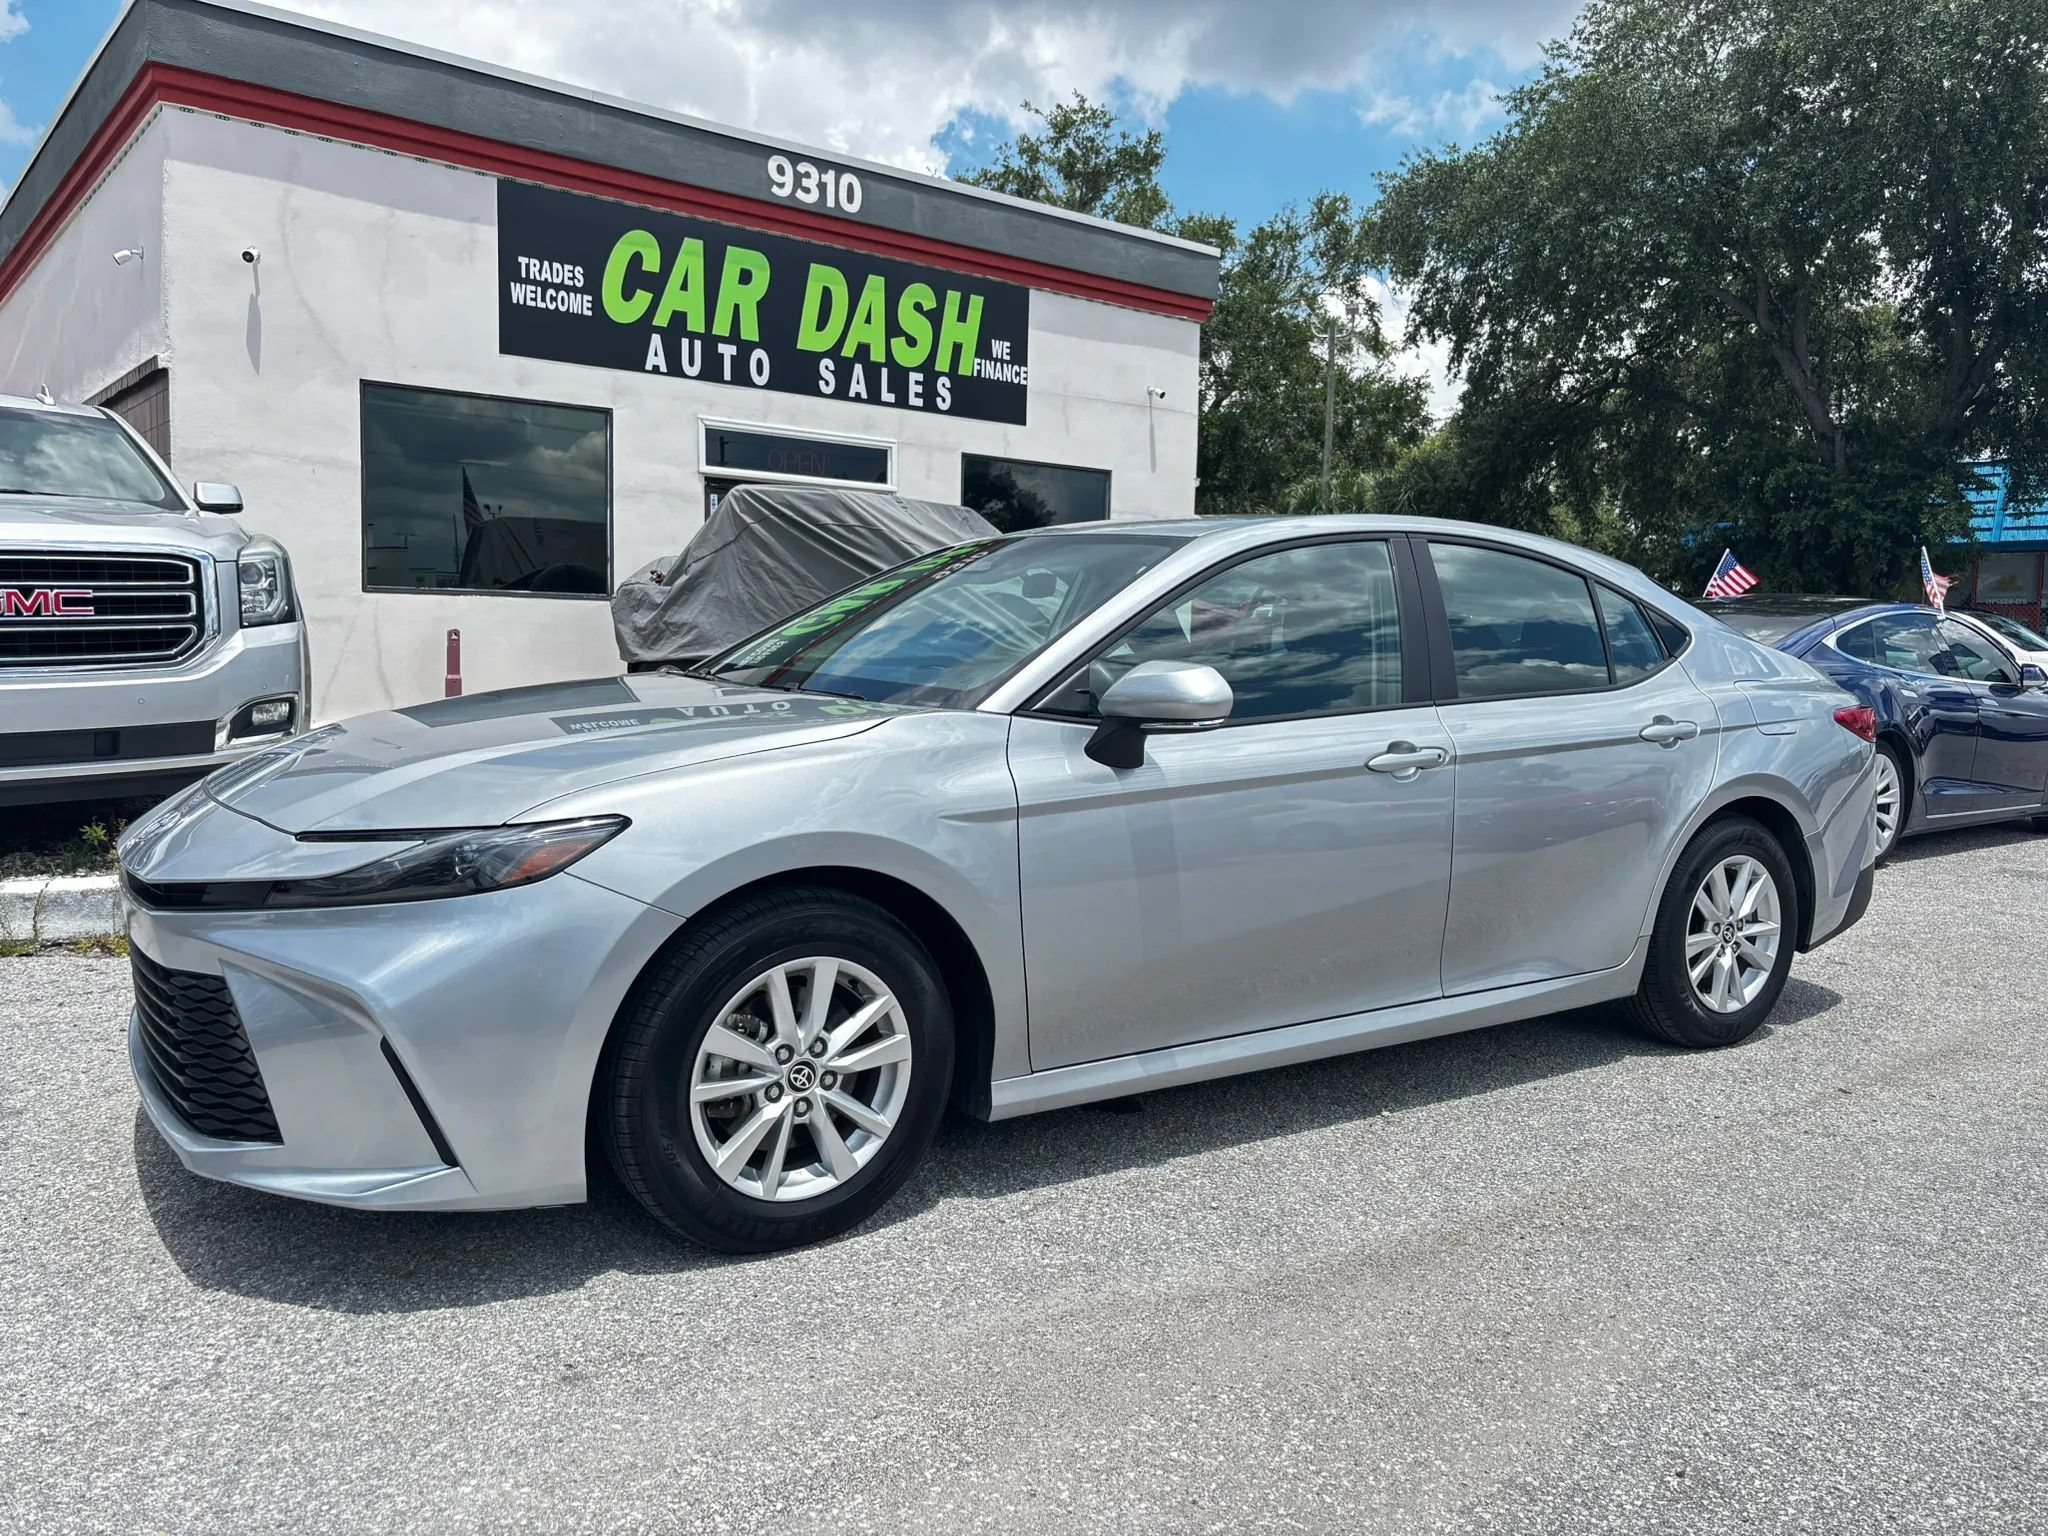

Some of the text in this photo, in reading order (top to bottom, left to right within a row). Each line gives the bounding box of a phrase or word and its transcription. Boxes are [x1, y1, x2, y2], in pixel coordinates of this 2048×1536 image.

[767, 154, 863, 214] 9310
[517, 255, 585, 288] TRADES
[510, 281, 593, 317] WELCOME
[601, 229, 984, 377] CAR DASH
[991, 338, 1011, 361] WE
[644, 332, 952, 411] AUTO SALES
[973, 357, 1028, 386] FINANCE
[767, 449, 827, 476] OPEN
[0, 588, 95, 616] MC
